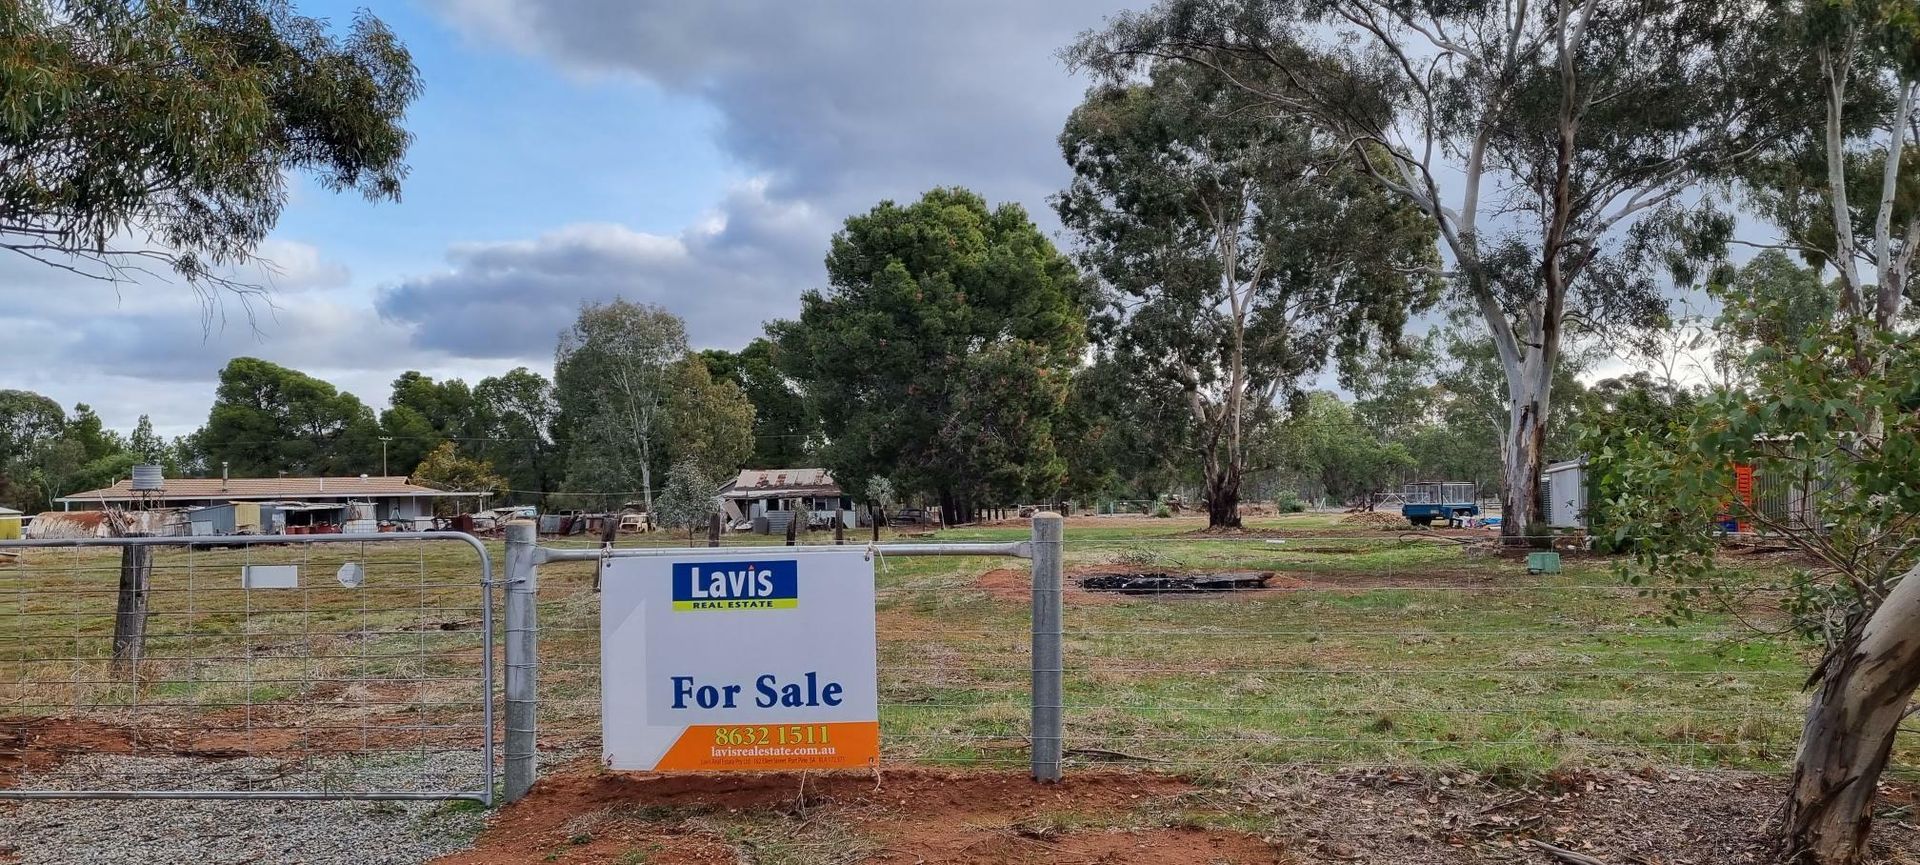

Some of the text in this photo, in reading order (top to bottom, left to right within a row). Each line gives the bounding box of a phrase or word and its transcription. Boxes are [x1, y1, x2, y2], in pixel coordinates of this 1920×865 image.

[691, 564, 774, 598] Lavis
[693, 600, 773, 609] REAL ESTATE
[671, 671, 843, 709] For Sale
[715, 725, 830, 746] 8632 1511
[711, 745, 836, 758] lavisrealestate.com.au
